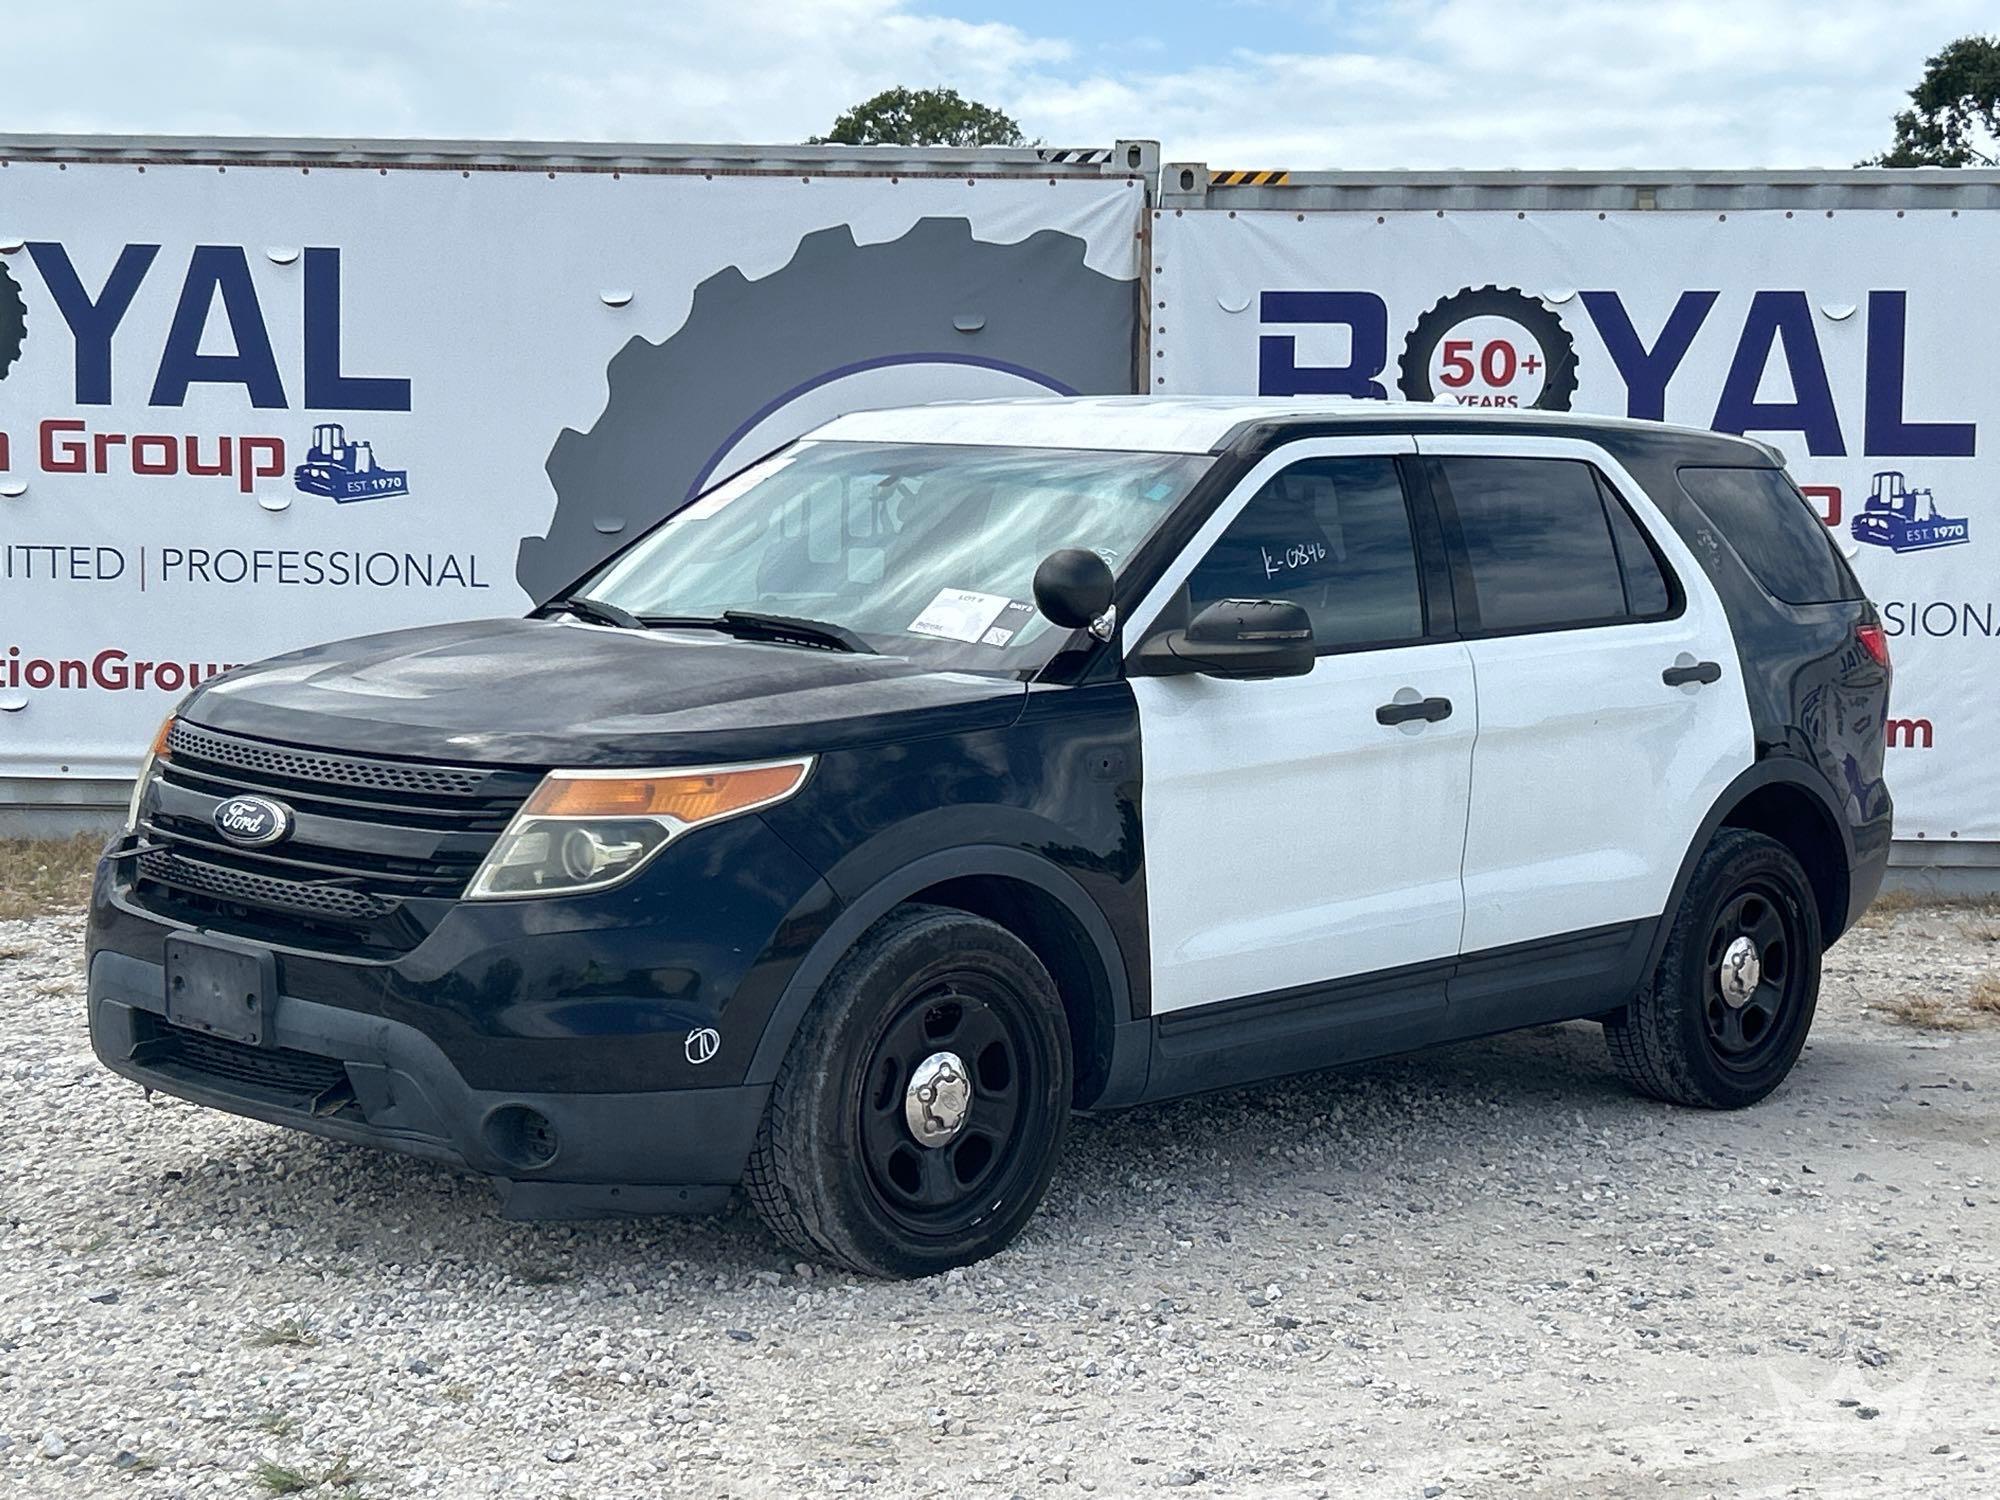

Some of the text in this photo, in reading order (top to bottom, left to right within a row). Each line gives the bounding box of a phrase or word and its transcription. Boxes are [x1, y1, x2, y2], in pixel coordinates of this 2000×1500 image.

[0, 241, 412, 411] YAL
[1439, 340, 1542, 388] 50+
[40, 420, 286, 493] Group
[347, 478, 402, 492] EST. 1970
[1933, 525, 1964, 538] 1970
[163, 549, 490, 588] PROFESSIONAL
[223, 802, 265, 832] Ford
